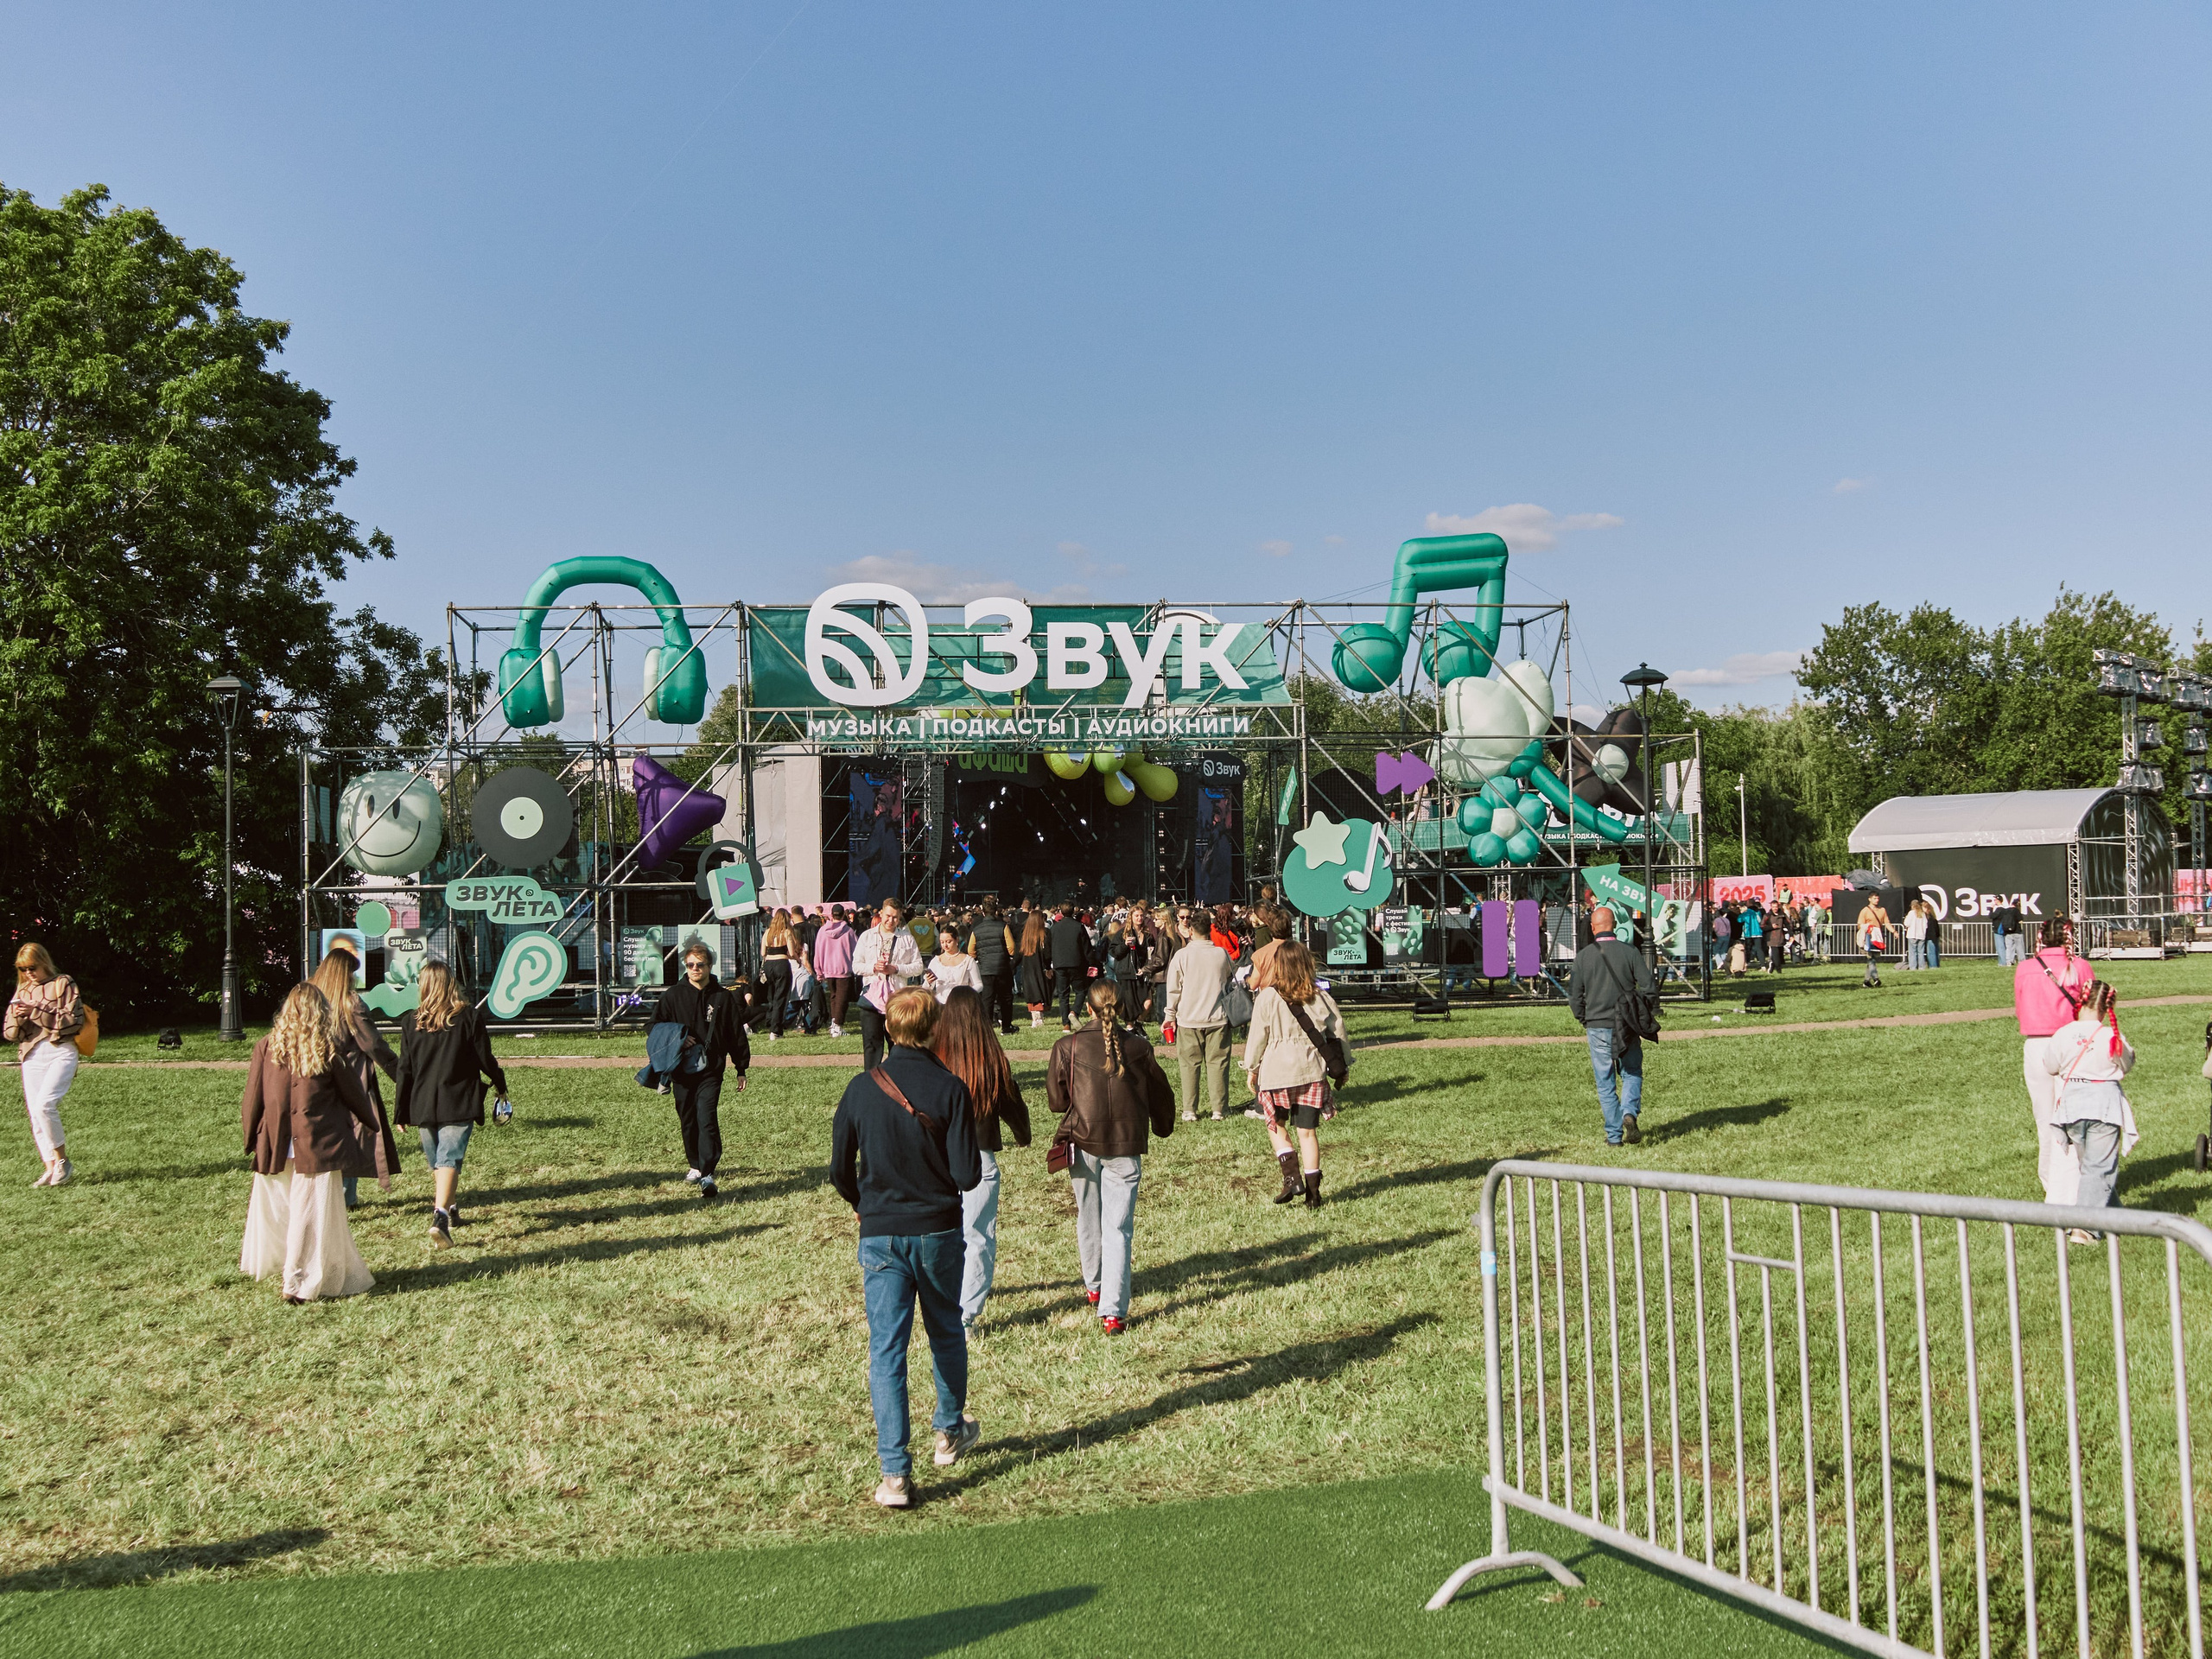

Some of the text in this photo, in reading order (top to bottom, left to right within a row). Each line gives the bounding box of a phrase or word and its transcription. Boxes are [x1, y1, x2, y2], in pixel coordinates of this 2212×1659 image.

[963, 597, 1249, 709] Звук
[808, 719, 912, 736] МУЗЫКА
[933, 718, 1065, 737] ПОДКАСТЫ
[1087, 717, 1249, 736] АУДИОКНИГИ
[1216, 761, 1241, 777] Звук
[1599, 874, 1618, 892] НА
[456, 885, 524, 901] ЗВУК
[1719, 885, 1766, 904] 2025
[492, 900, 558, 917] ЛЕТА
